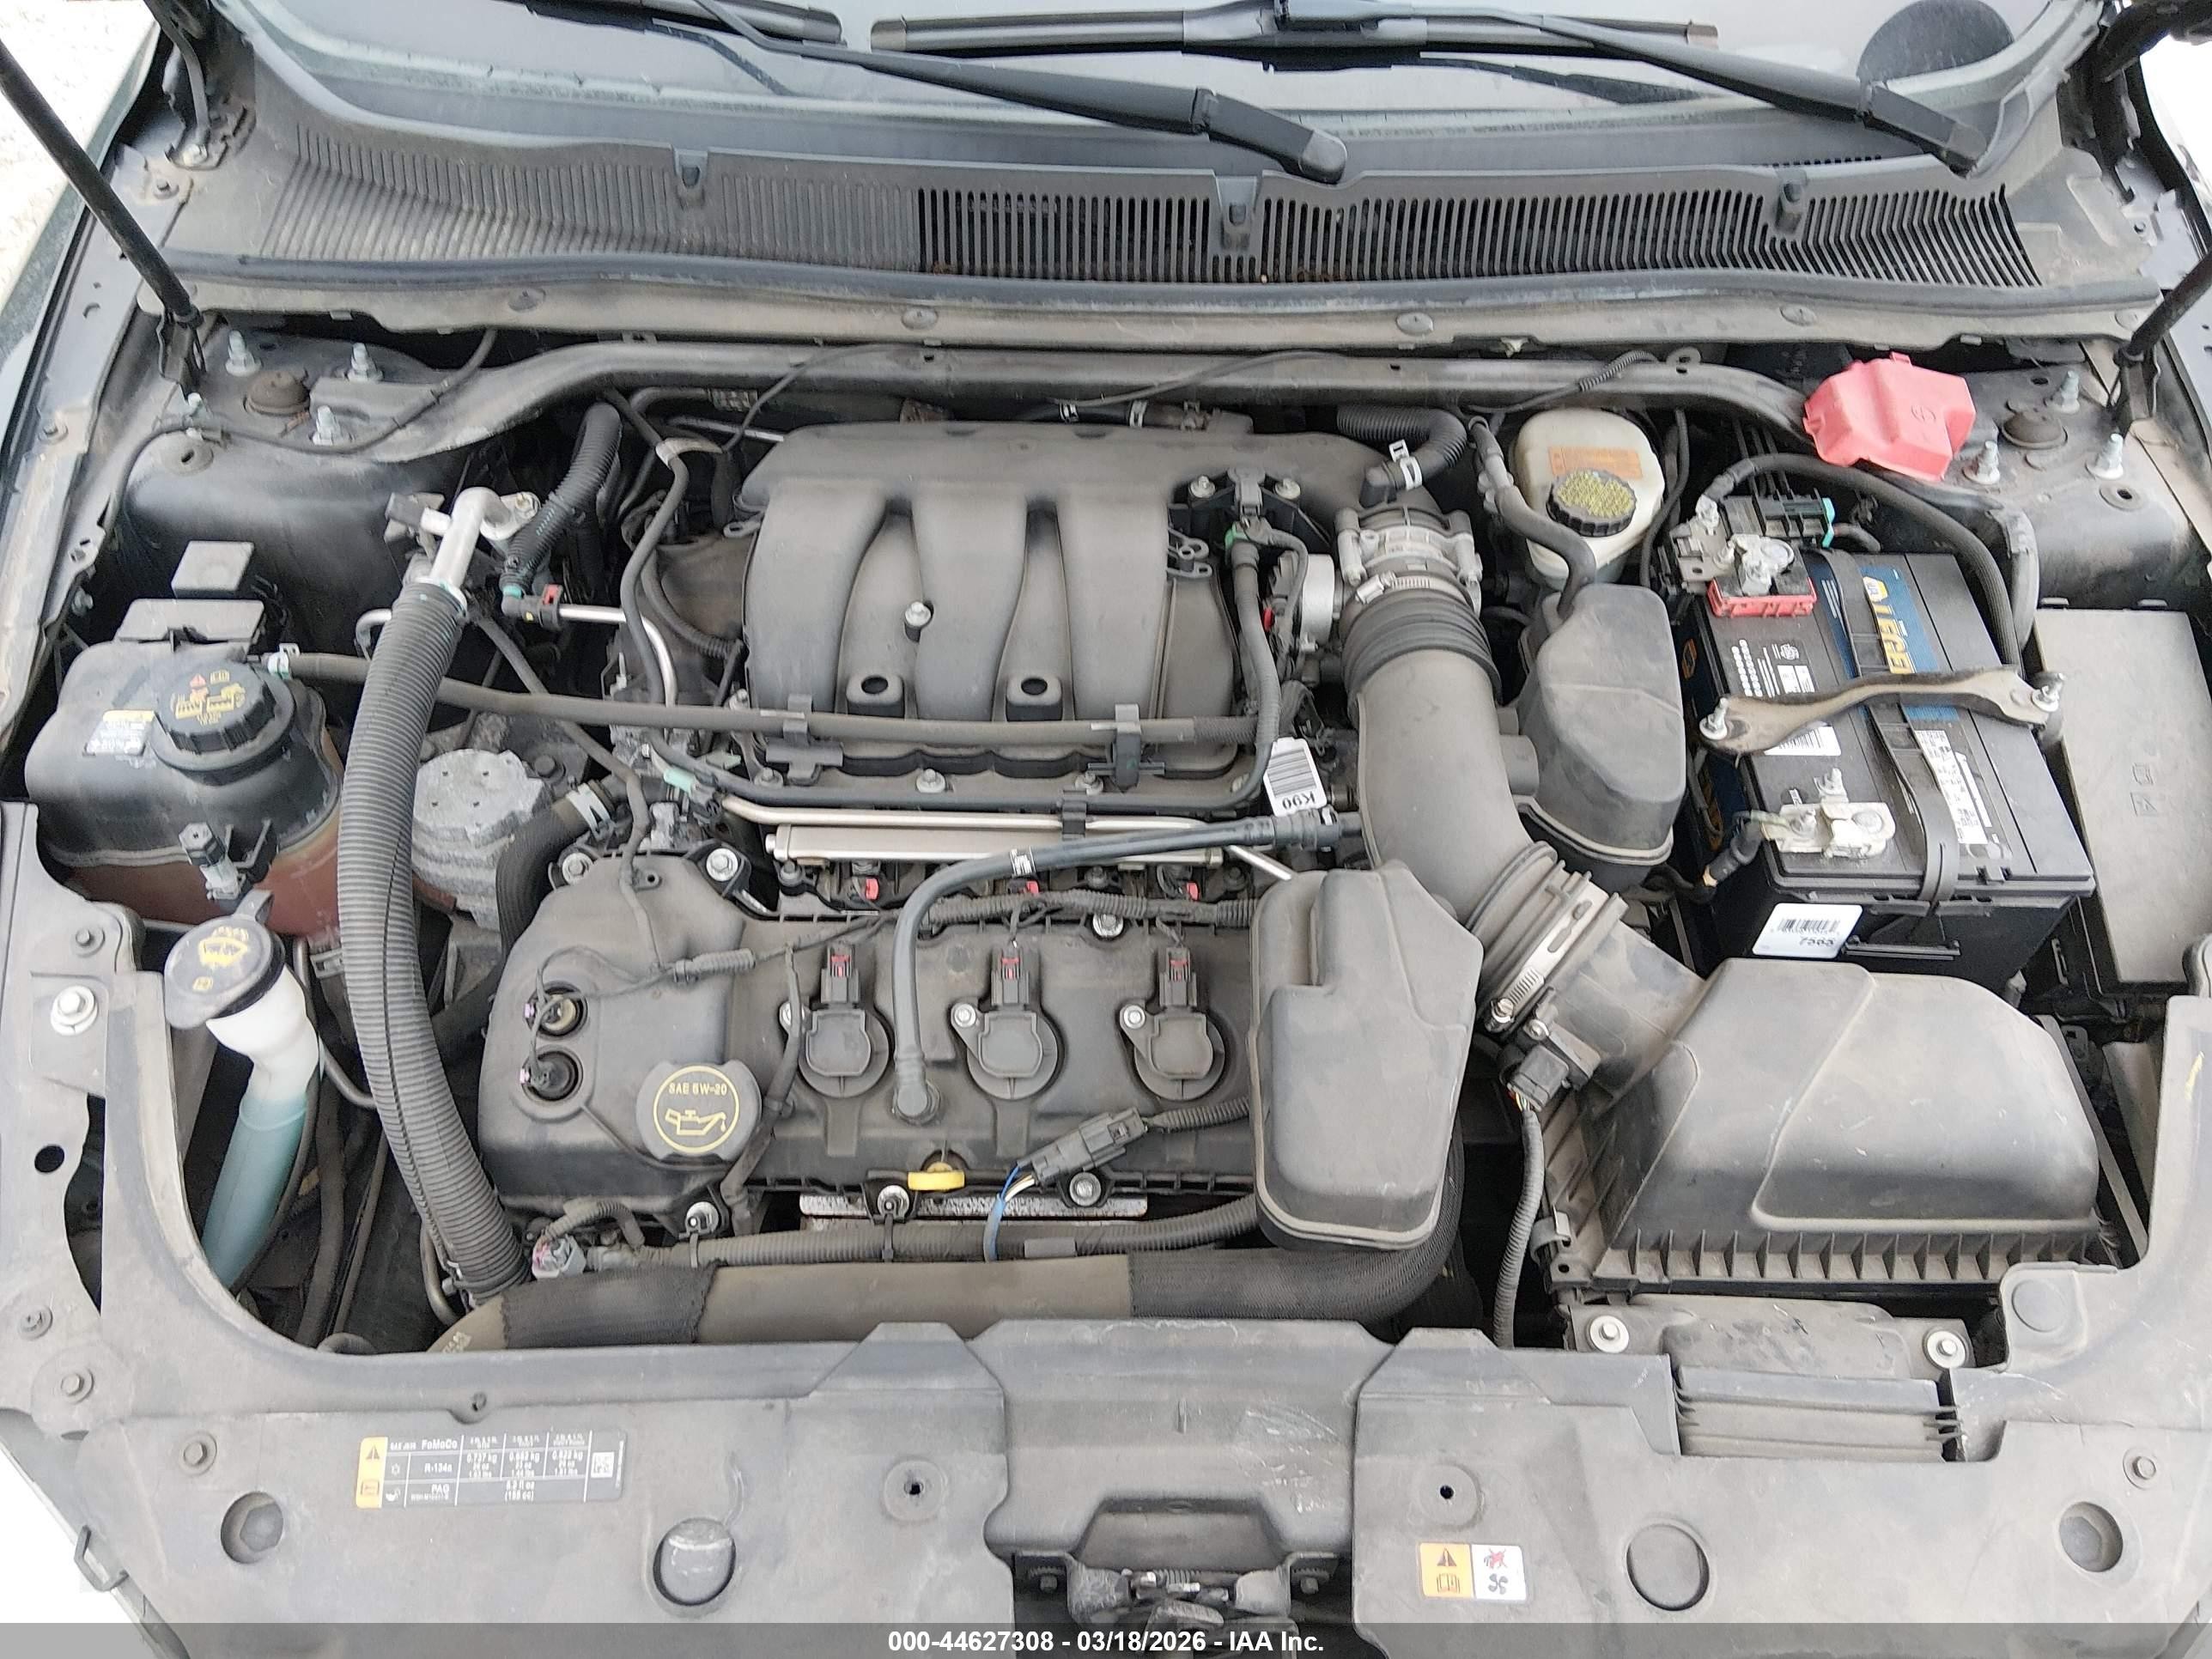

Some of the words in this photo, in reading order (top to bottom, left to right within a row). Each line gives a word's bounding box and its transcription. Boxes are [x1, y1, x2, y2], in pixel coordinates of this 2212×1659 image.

[1282, 791, 1316, 809] K90
[668, 1083, 690, 1095] SAE
[692, 1083, 727, 1096] 5W-20
[422, 1438, 458, 1449] FoMoCo
[424, 1462, 453, 1473] R-134a
